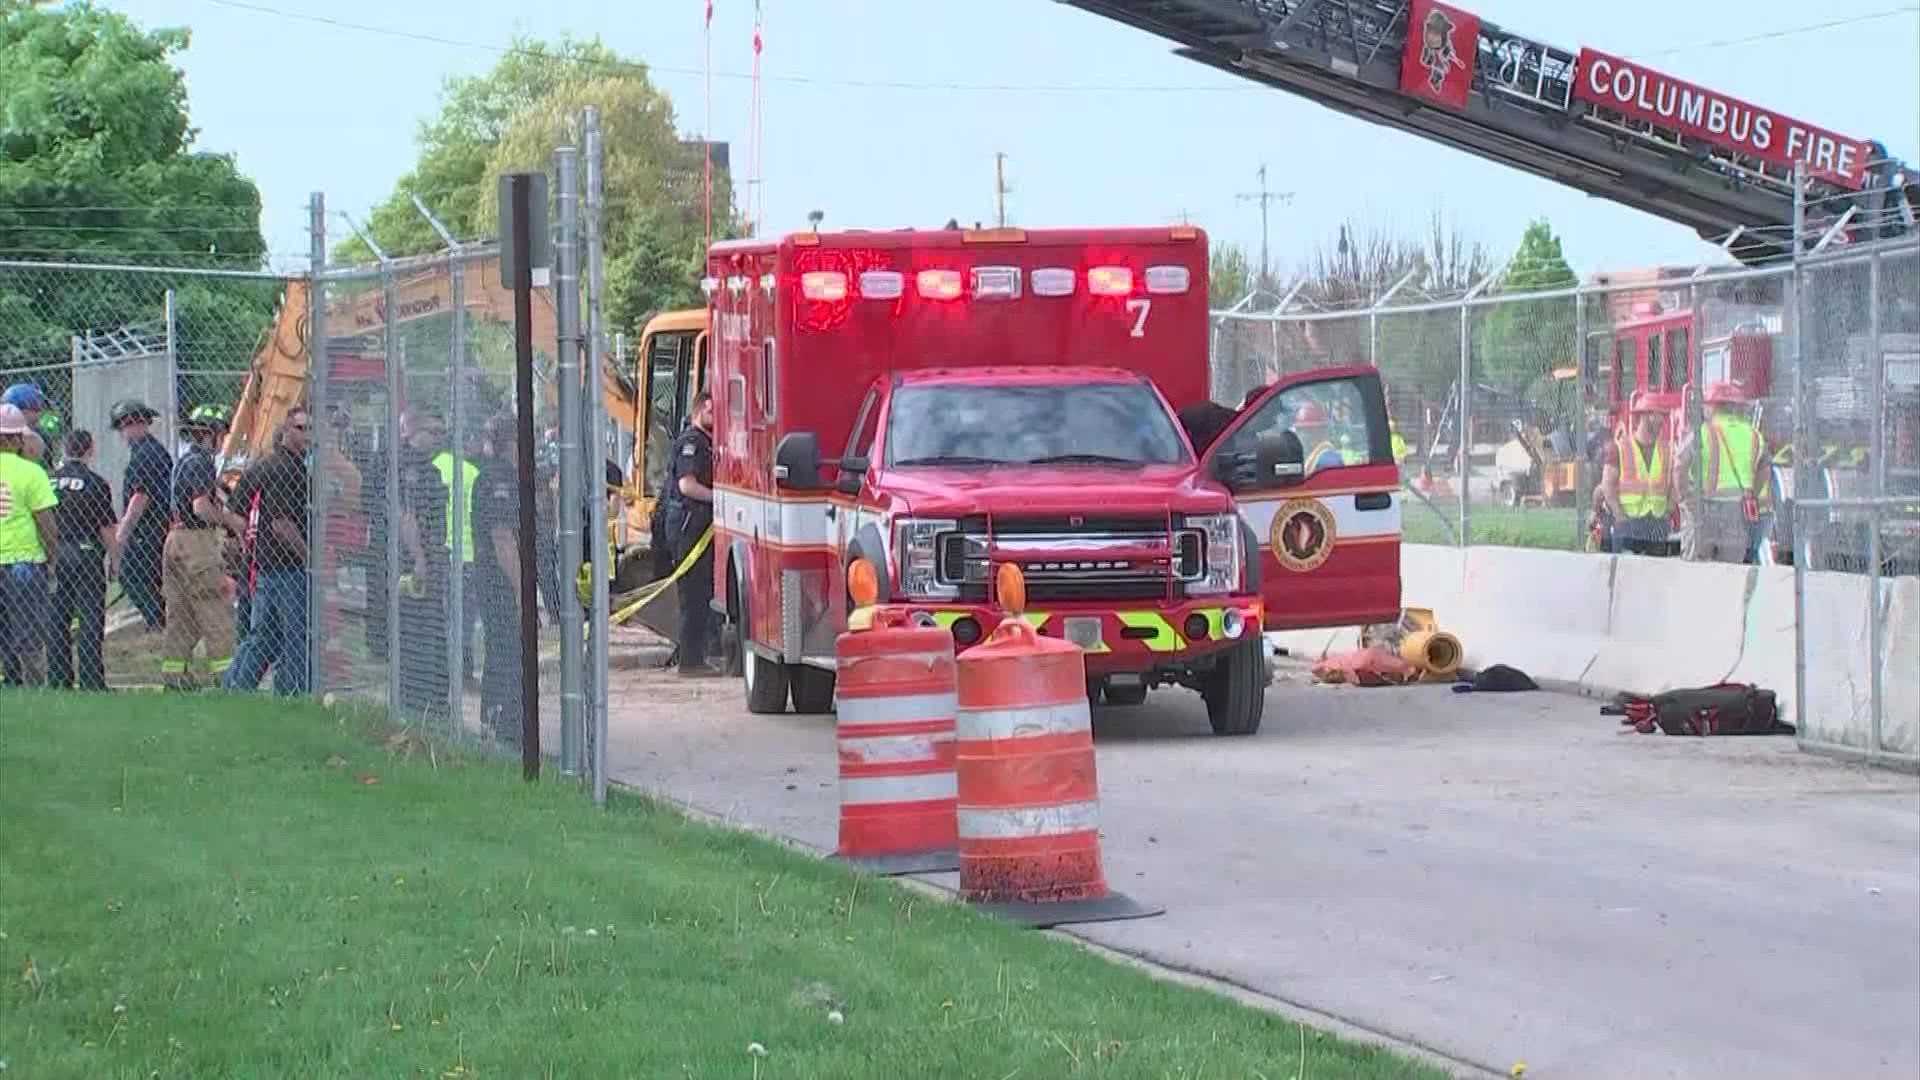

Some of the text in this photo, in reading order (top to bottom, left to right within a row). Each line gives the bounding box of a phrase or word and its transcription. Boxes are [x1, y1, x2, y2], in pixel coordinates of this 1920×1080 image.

[1589, 59, 1857, 178] COLUMBUS FIRE
[1126, 299, 1150, 337] 7
